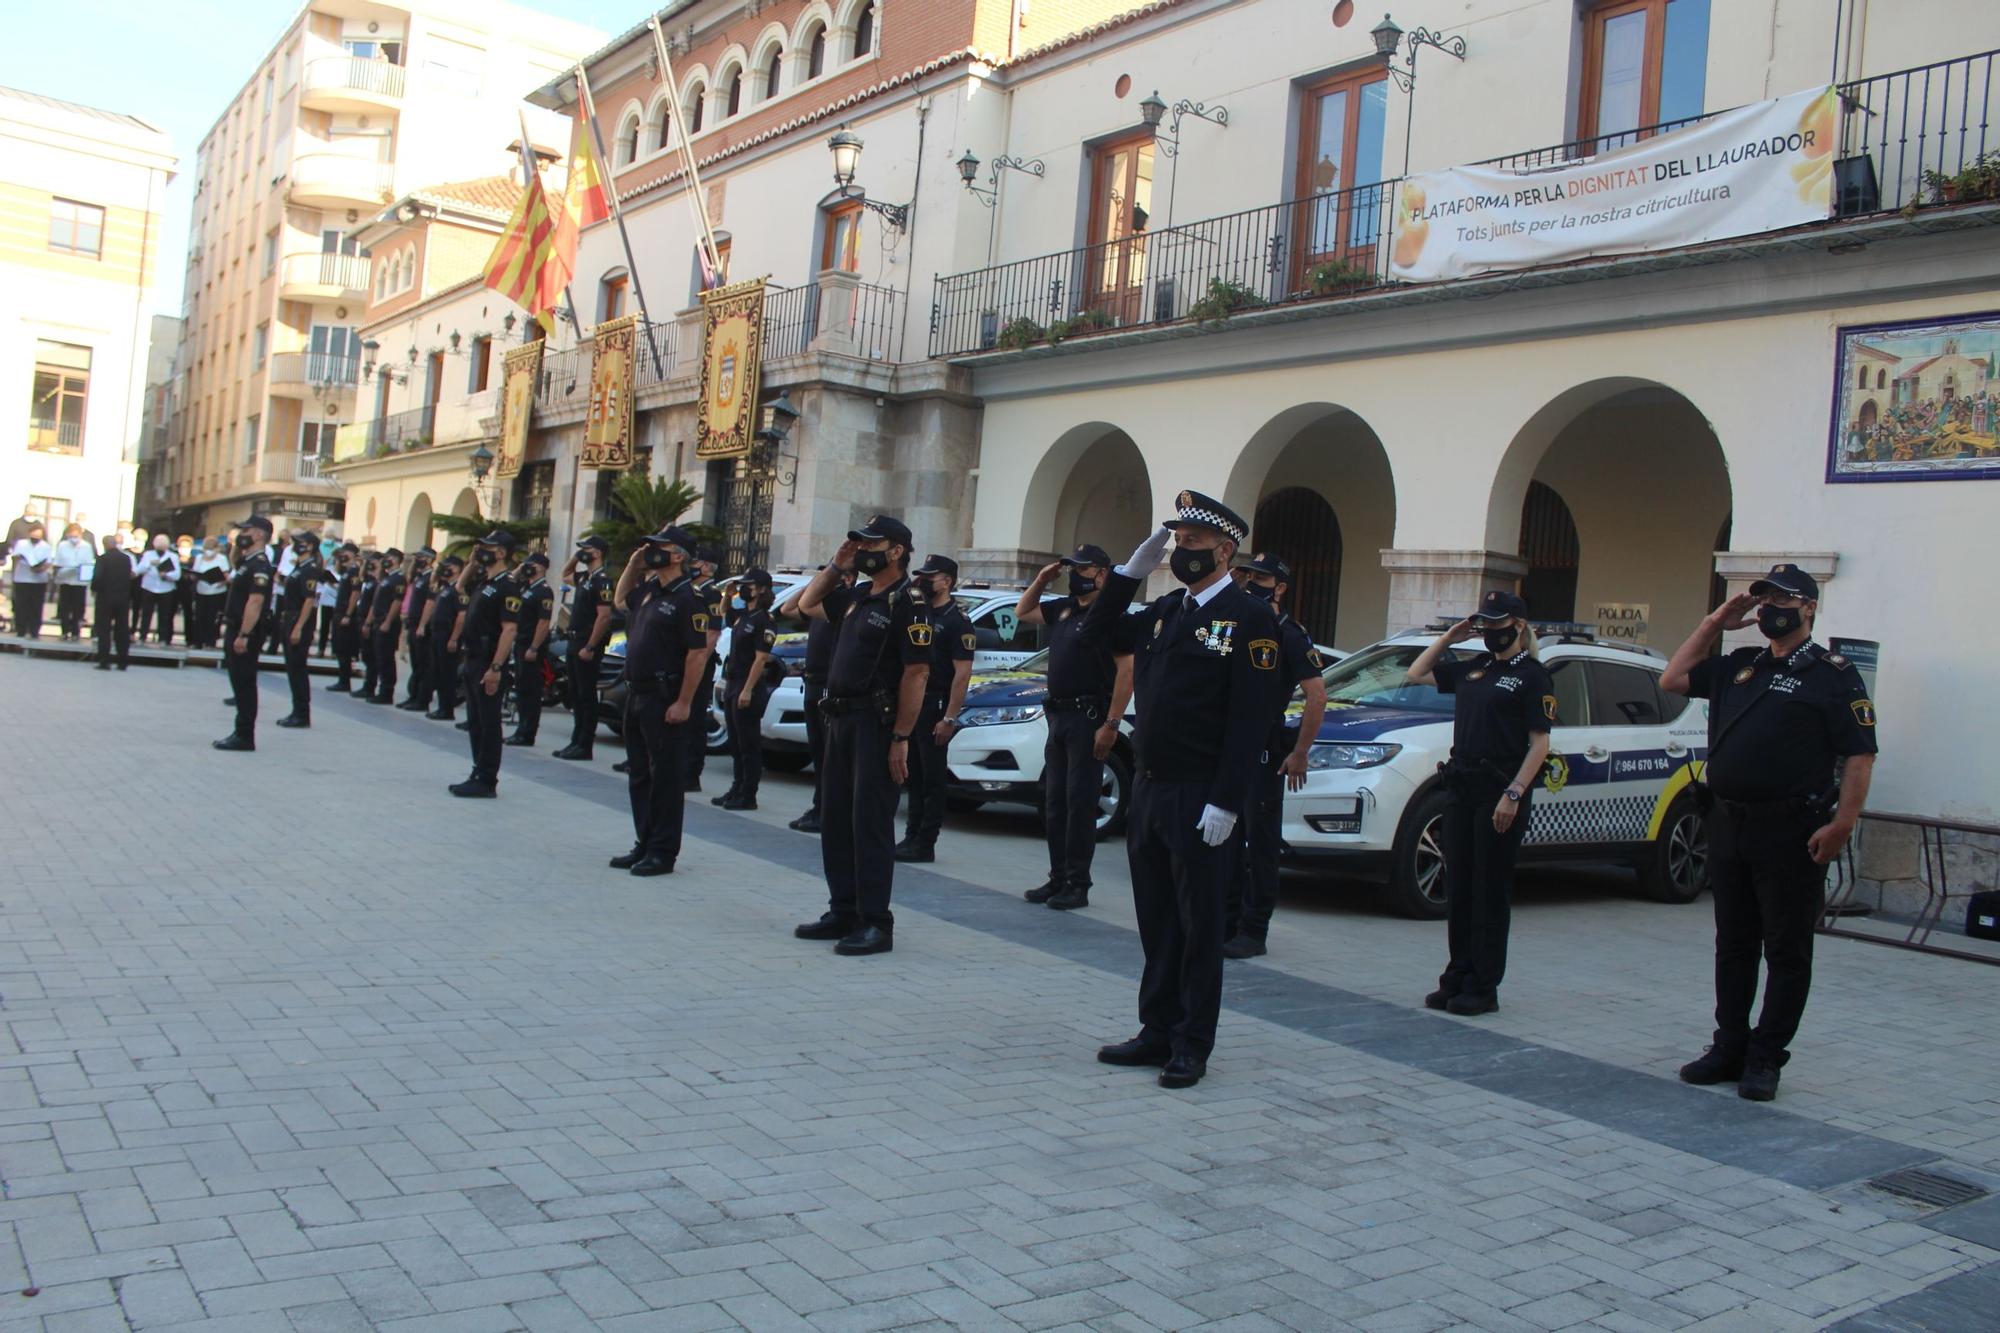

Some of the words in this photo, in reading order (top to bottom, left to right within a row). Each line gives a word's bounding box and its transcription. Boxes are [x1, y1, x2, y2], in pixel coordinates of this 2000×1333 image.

[1411, 194, 1510, 222] PLATAFORMA
[1515, 188, 1543, 207] PER
[1544, 184, 1566, 203] LA
[1567, 166, 1648, 198] DIGNITAT
[1655, 160, 1692, 182] DEL
[1696, 130, 1816, 173] LLAURADOR
[1456, 224, 1488, 243] Tots
[1489, 219, 1525, 241] junts
[1528, 218, 1557, 237] per
[1561, 213, 1577, 230] la
[1579, 207, 1632, 228] nostra
[1636, 184, 1732, 216] citricultura
[1598, 607, 1642, 620] POLICIA
[1599, 625, 1637, 638] LOCAL
[1621, 759, 1636, 772] 964
[1638, 759, 1652, 771] 670
[1654, 758, 1669, 770] 164
